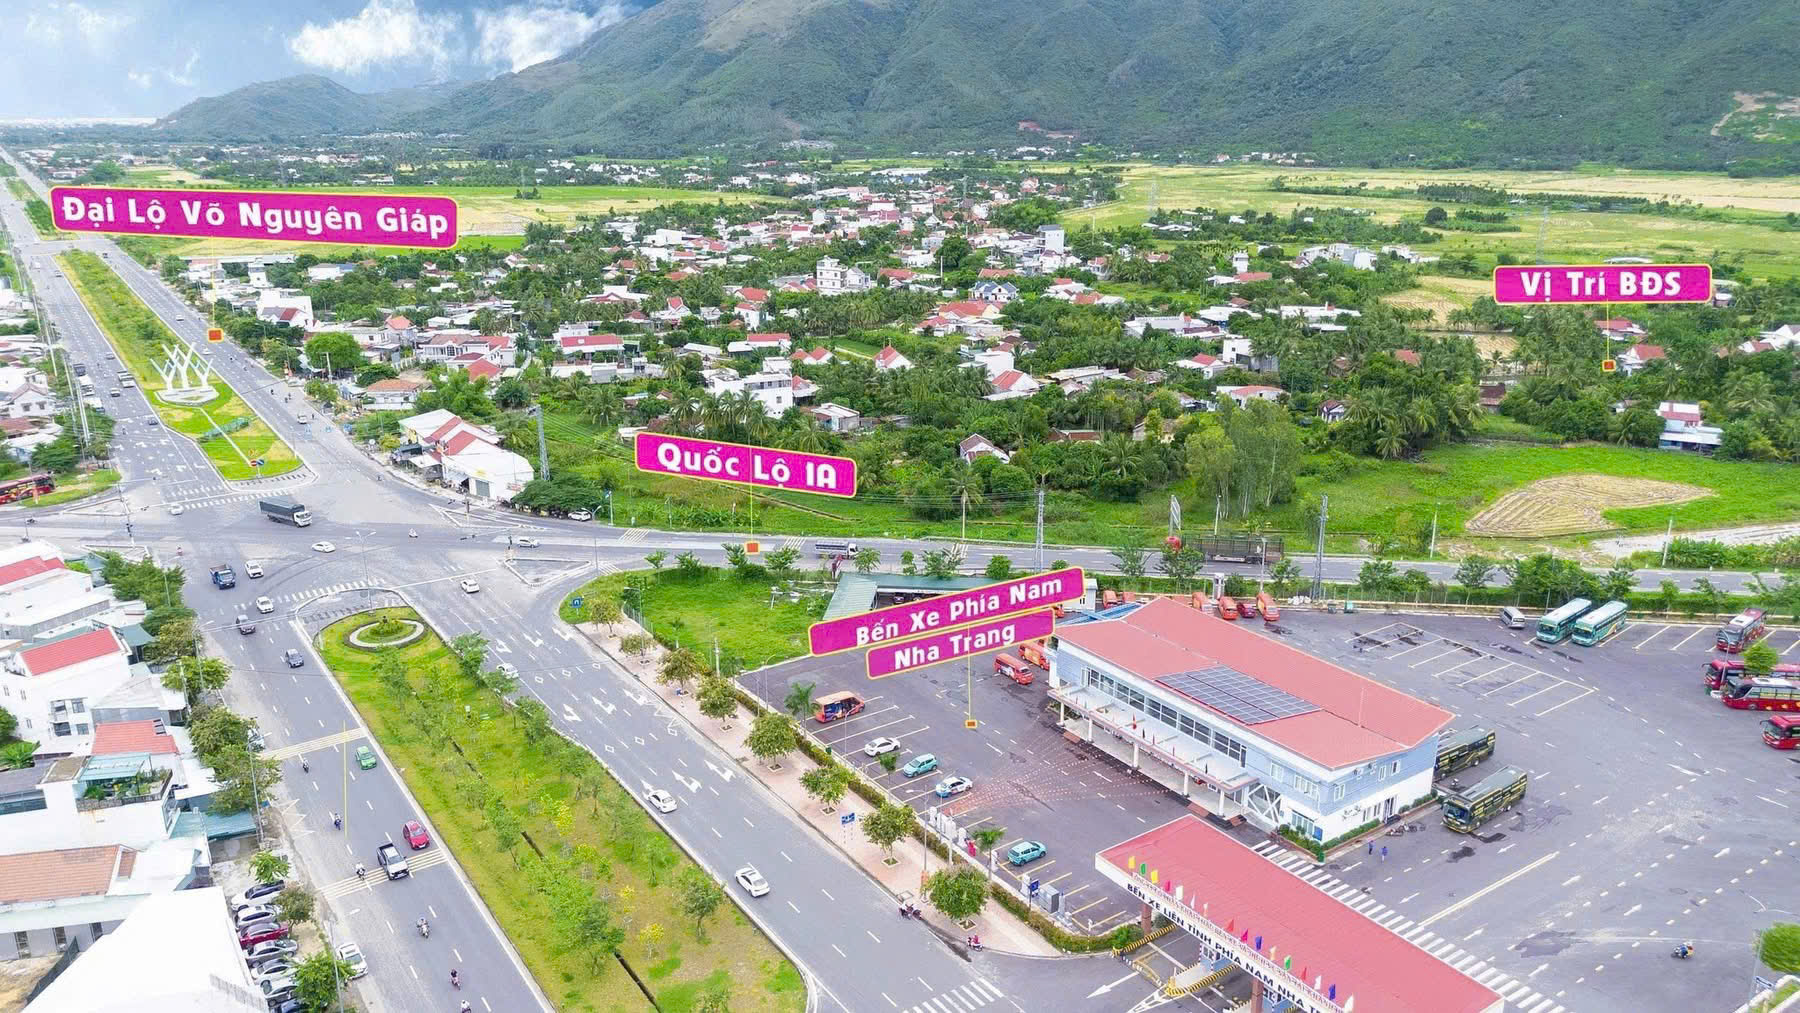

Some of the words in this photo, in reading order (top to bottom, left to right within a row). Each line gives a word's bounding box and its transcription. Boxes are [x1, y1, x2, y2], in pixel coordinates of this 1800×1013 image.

[1127, 883, 1146, 900] BẾN
[1148, 898, 1161, 910] XE
[1163, 907, 1185, 926] LIÊN
[1215, 942, 1242, 965] PHÍA
[1245, 962, 1274, 987] NAM
[1277, 985, 1305, 1008] NHA
